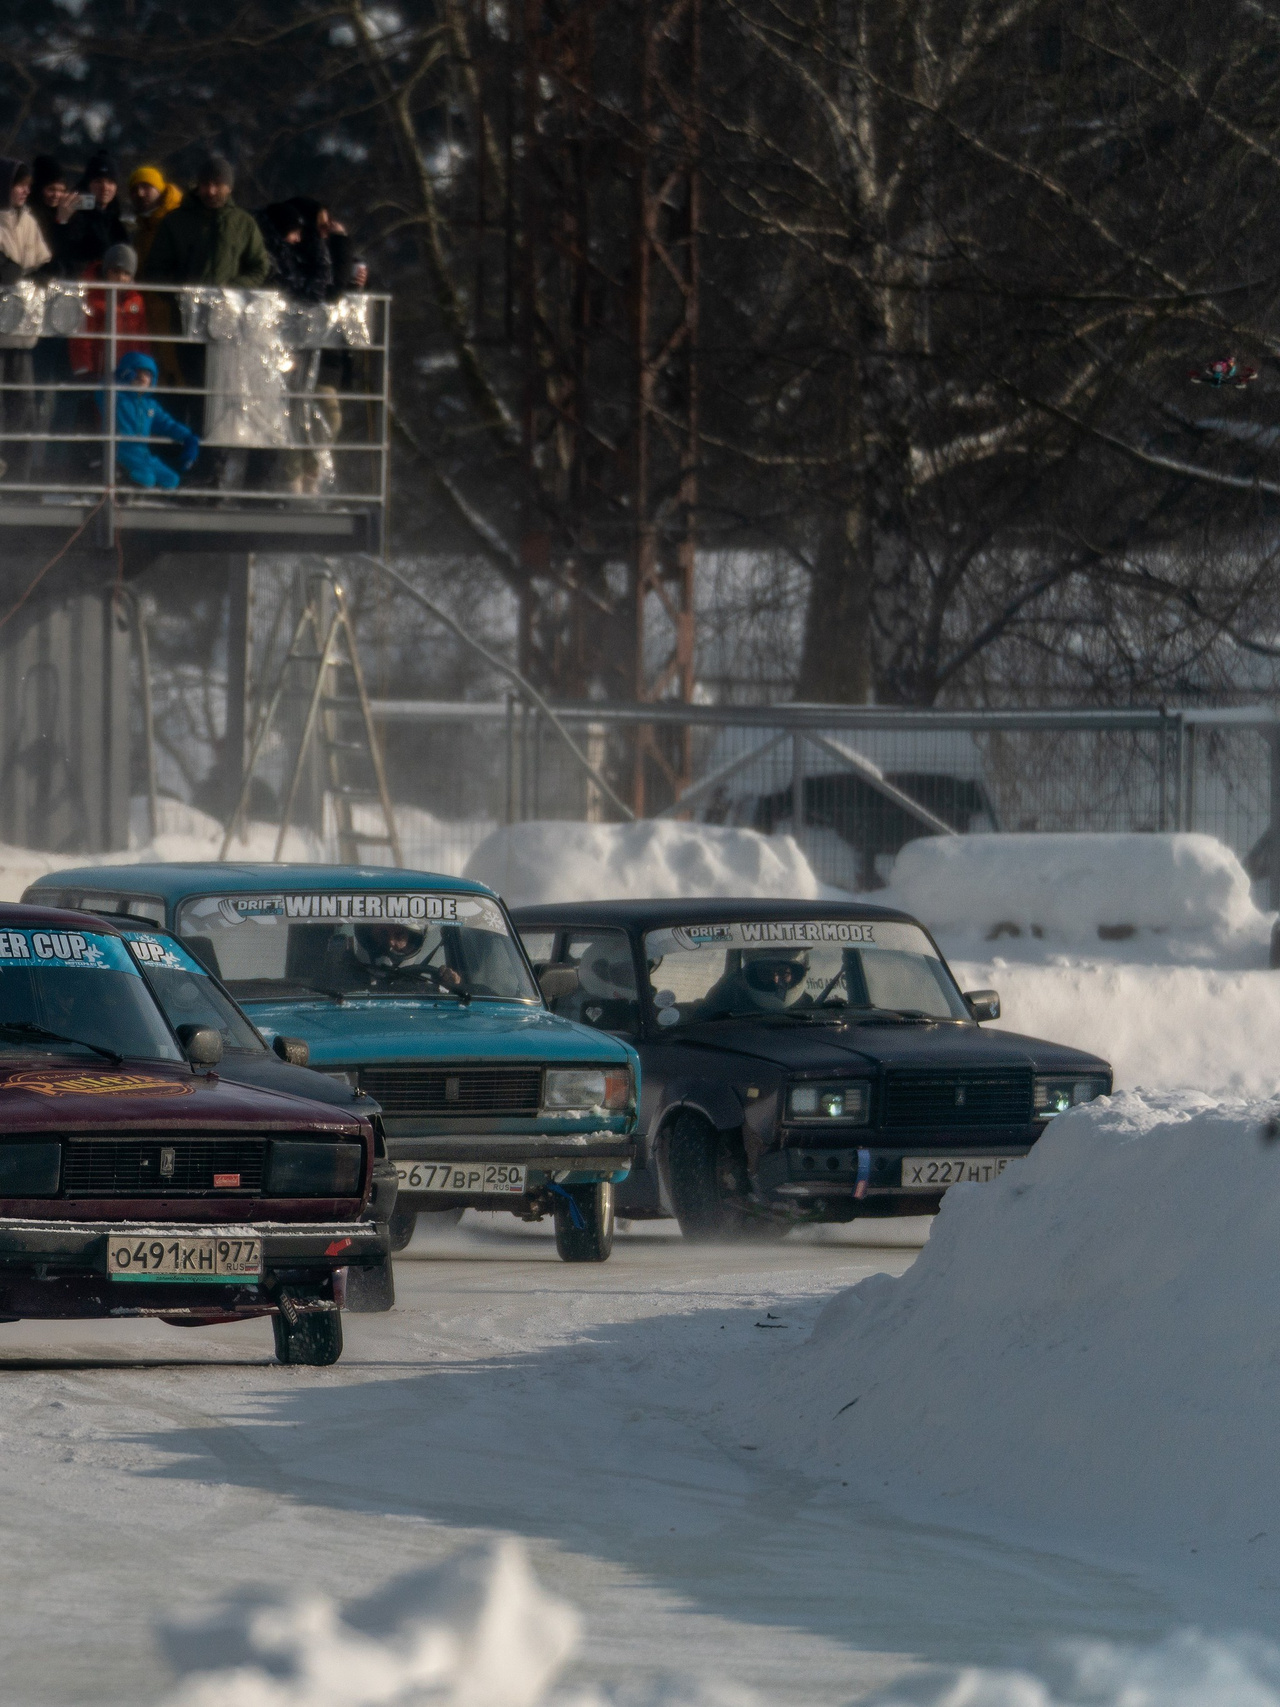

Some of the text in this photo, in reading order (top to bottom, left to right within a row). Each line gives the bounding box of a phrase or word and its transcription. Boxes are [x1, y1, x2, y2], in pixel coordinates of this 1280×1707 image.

[238, 895, 458, 920] DRIFT WINTER MODE
[690, 924, 875, 942] DRIFT WINTER MODE
[33, 933, 89, 961] CUP
[486, 1166, 520, 1184] 250
[493, 1183, 510, 1191] RUS
[217, 1240, 256, 1263] 977
[226, 1262, 245, 1271] RUS
